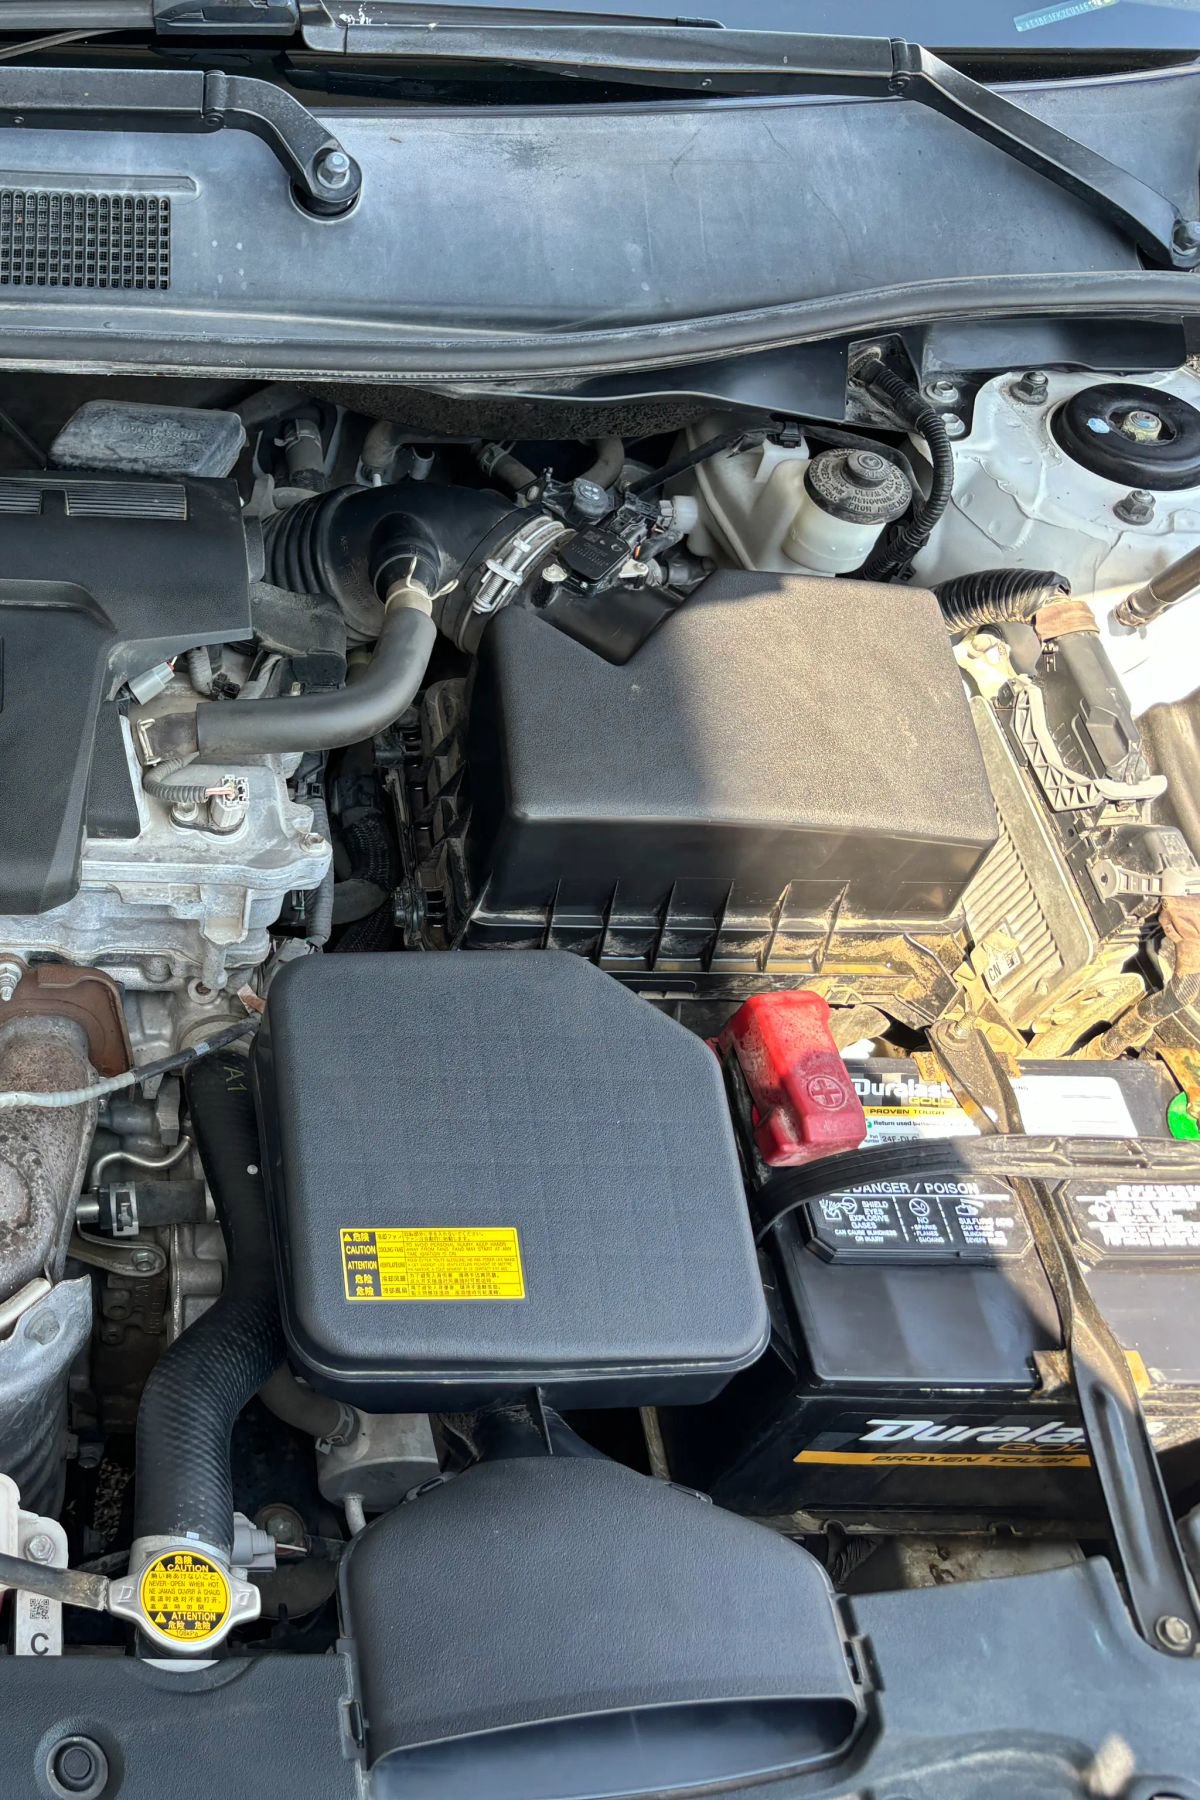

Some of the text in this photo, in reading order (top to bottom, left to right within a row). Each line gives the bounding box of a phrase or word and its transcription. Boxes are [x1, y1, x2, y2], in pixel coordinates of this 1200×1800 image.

[988, 961, 1002, 982] CN
[223, 1066, 248, 1091] A1
[851, 1078, 952, 1099] Duralast
[924, 1182, 980, 1195] POISON
[861, 1200, 889, 1209] SHIELD
[864, 1208, 884, 1216] EYES
[346, 1245, 376, 1255] CAUTION
[347, 1260, 378, 1270] ATTENTION
[858, 1419, 1087, 1443] Durala
[997, 1442, 1088, 1452] GOL
[872, 1455, 980, 1463] PROVEN
[167, 1563, 209, 1572] CAUTION
[171, 1611, 216, 1621] ATTENTION
[31, 1633, 49, 1656] C
